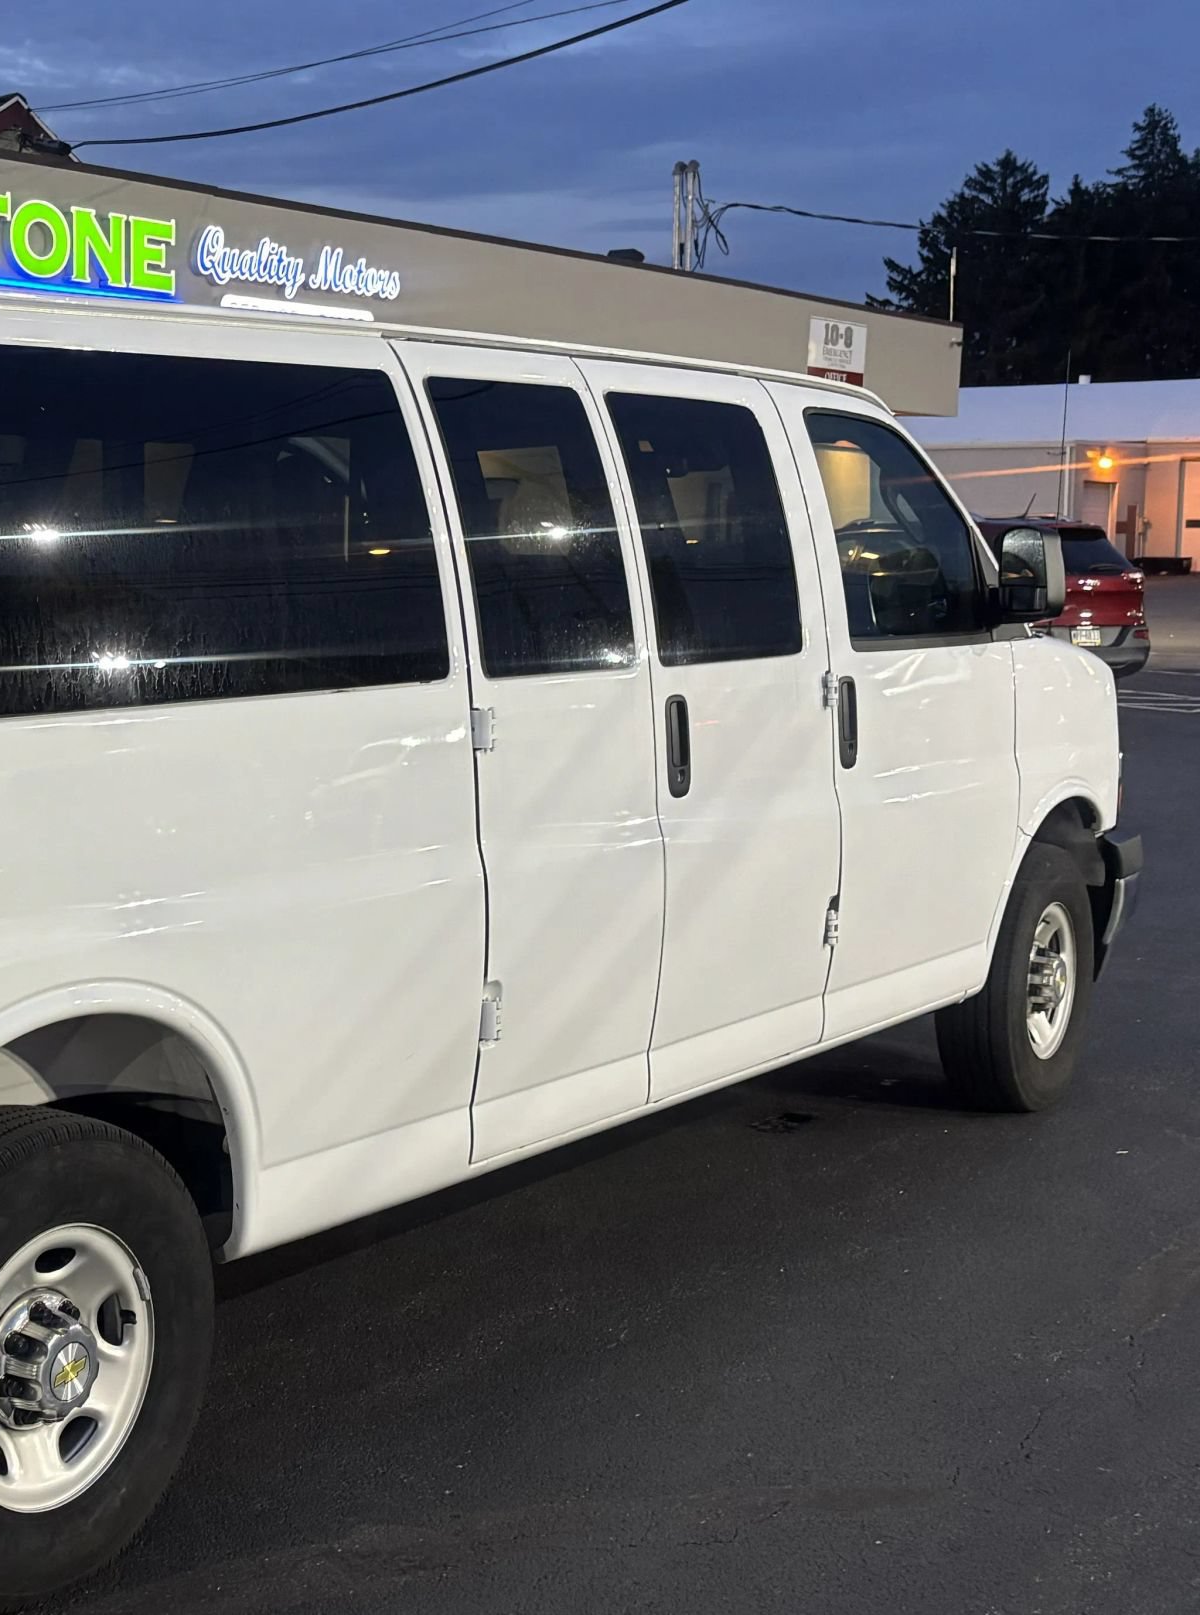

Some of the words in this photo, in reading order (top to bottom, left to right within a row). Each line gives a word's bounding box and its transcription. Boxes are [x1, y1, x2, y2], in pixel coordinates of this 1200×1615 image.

[197, 225, 305, 299] Quality
[309, 246, 401, 300] Motors
[824, 322, 853, 349] 10-8
